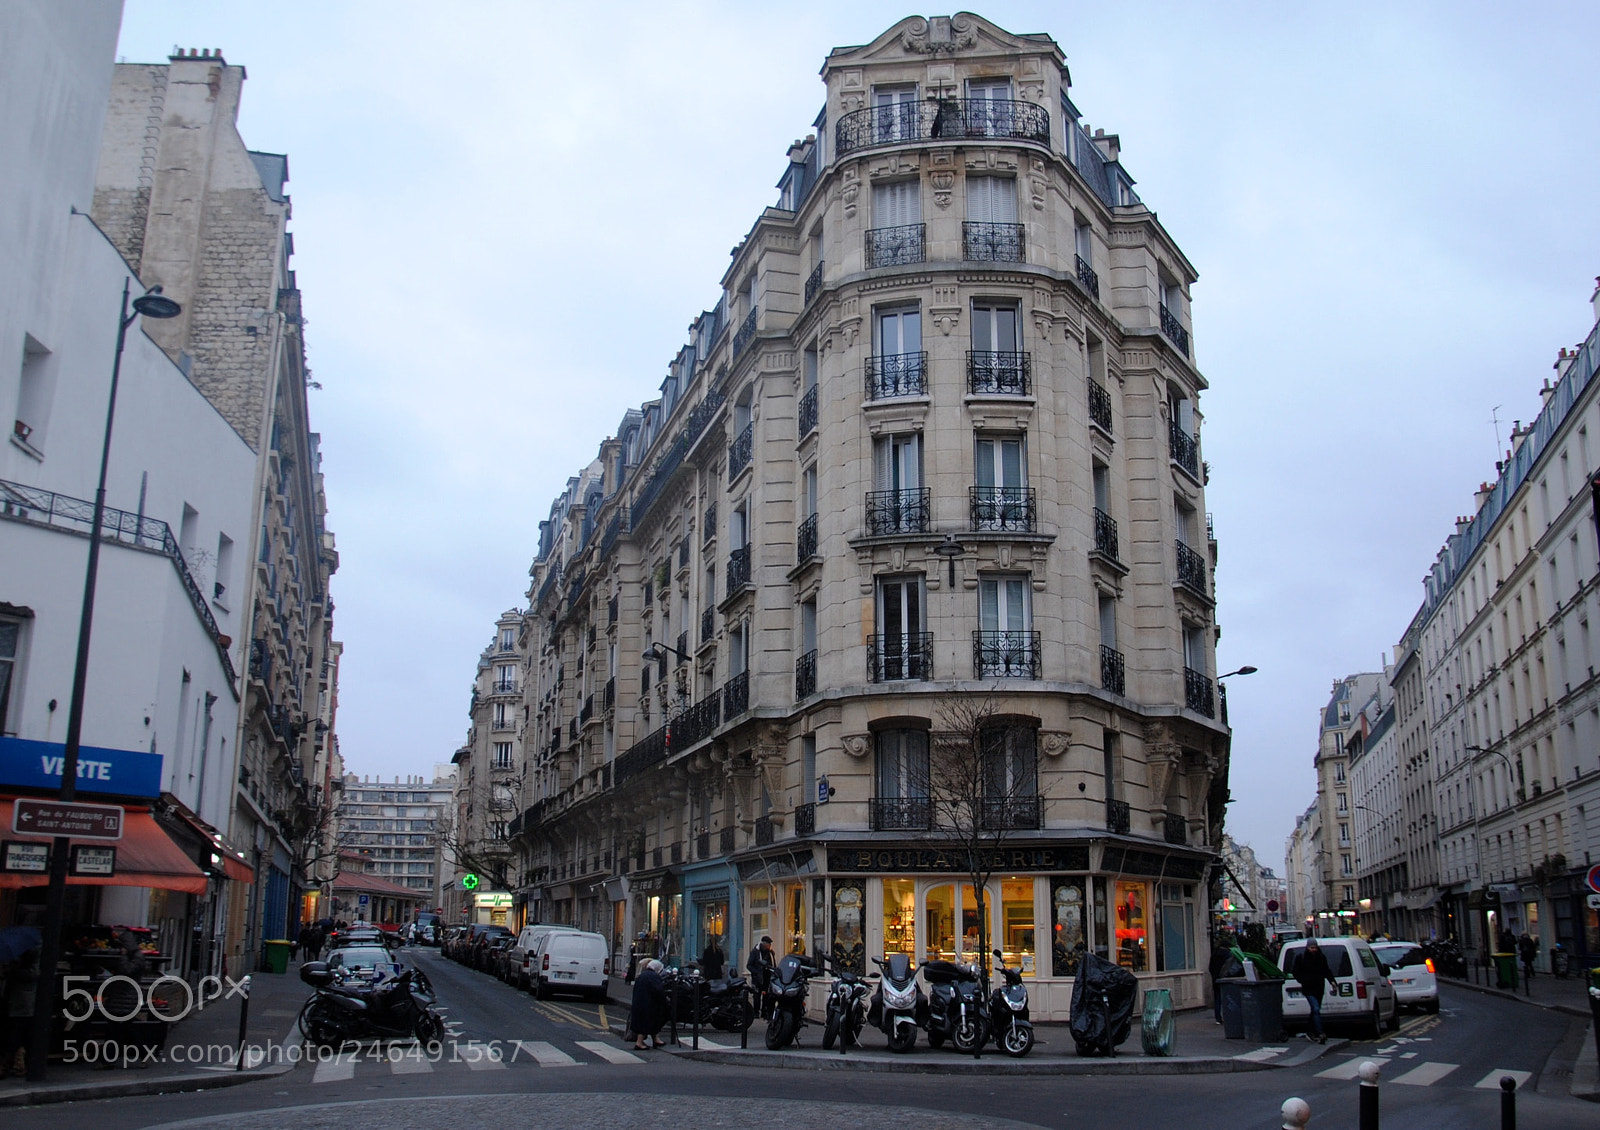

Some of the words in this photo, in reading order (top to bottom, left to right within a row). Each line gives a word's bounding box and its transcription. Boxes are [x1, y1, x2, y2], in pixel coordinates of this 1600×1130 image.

[41, 755, 112, 781] VERTE
[66, 811, 103, 821] FAUBOURG
[36, 820, 92, 830] SAINT-ANTOINE
[78, 856, 112, 865] CASTELAR
[1341, 983, 1350, 993] E
